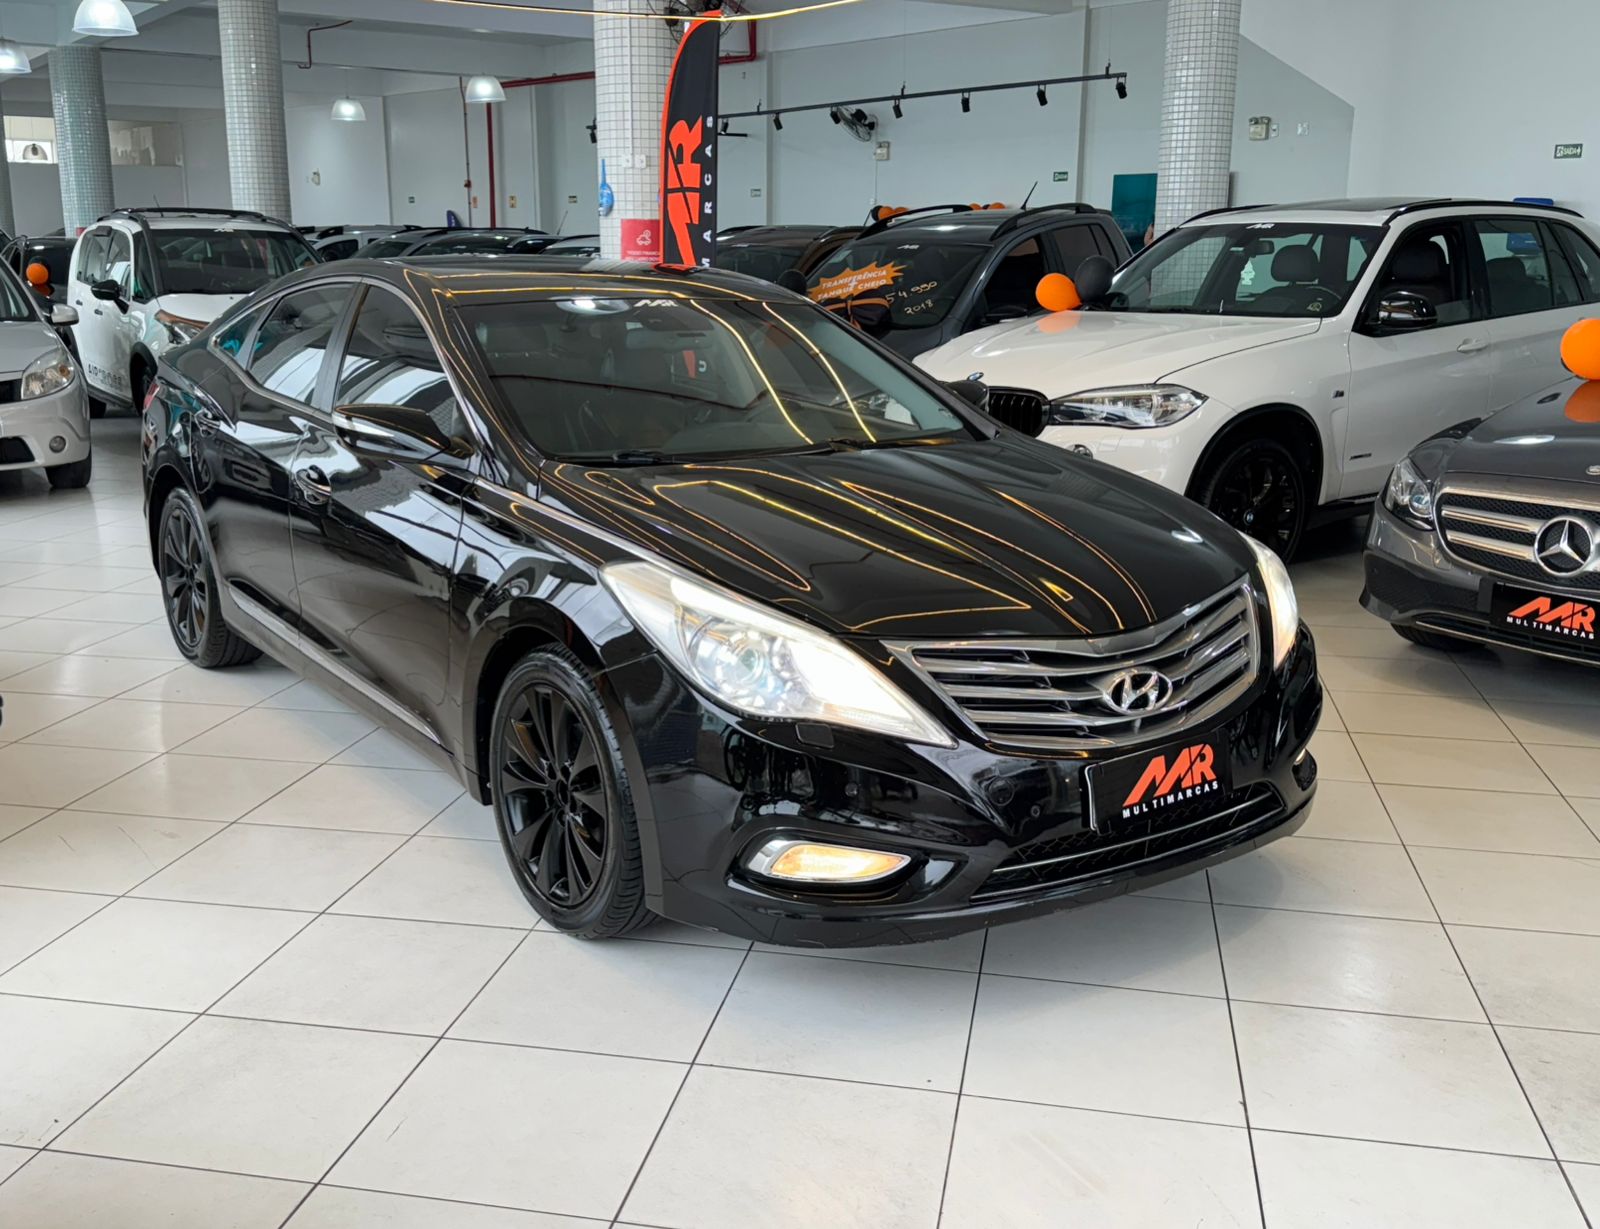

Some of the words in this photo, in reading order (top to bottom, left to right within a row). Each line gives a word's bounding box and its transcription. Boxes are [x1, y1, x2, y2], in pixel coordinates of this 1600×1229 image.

[858, 280, 887, 290] CHEIO
[904, 299, 934, 315] 2018
[1506, 616, 1595, 640] MULTIMARCAS
[1122, 780, 1219, 819] MULTIMARCAS
